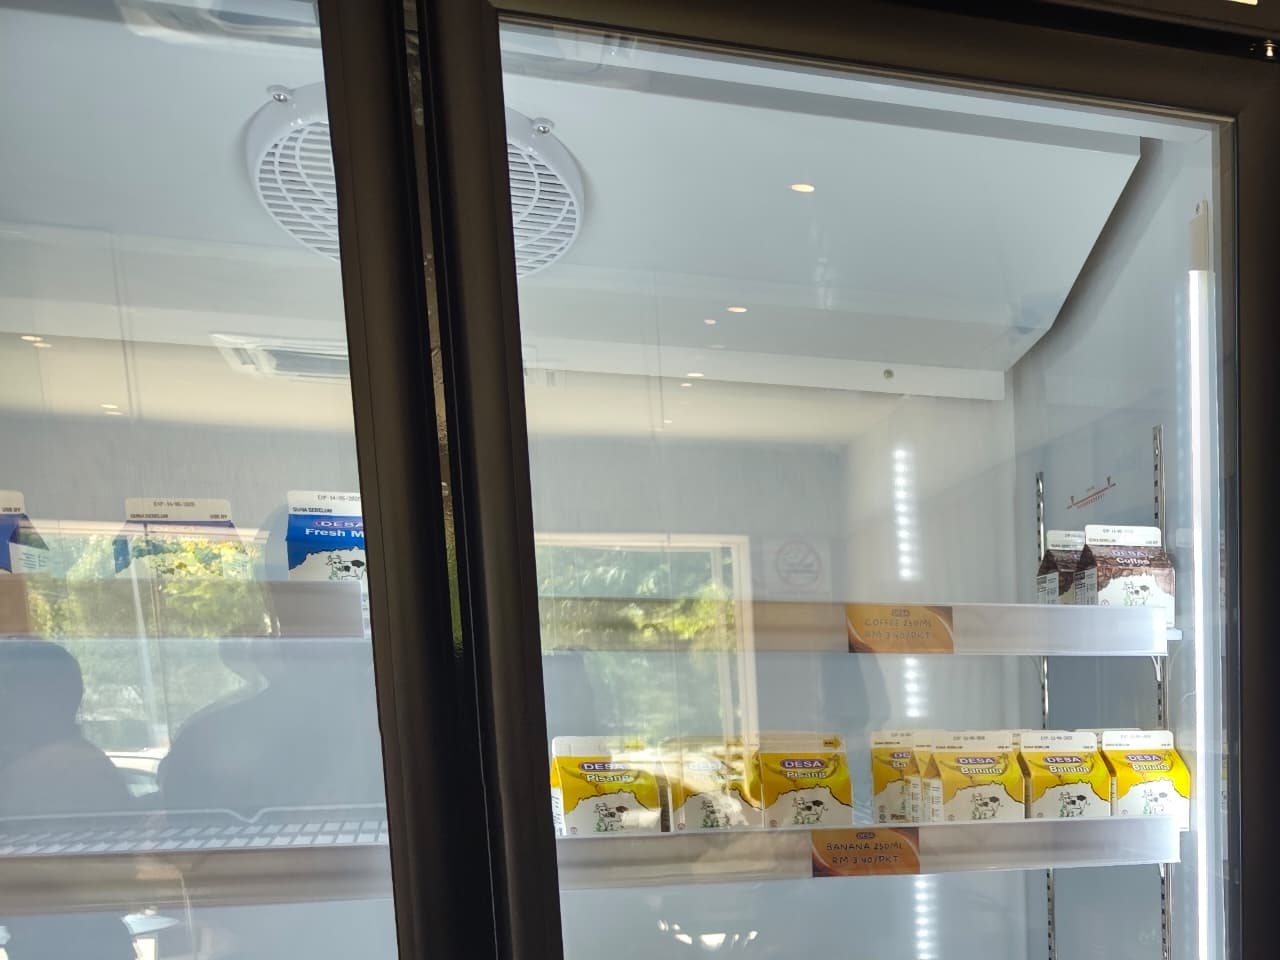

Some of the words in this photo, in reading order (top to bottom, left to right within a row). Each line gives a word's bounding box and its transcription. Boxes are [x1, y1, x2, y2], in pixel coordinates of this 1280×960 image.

[305, 528, 346, 537] Fresh
[583, 762, 625, 770] DESA
[785, 760, 822, 768] DESA
[1131, 763, 1171, 771] Banana
[1049, 765, 1091, 774] Banana
[826, 843, 870, 851] BANANA
